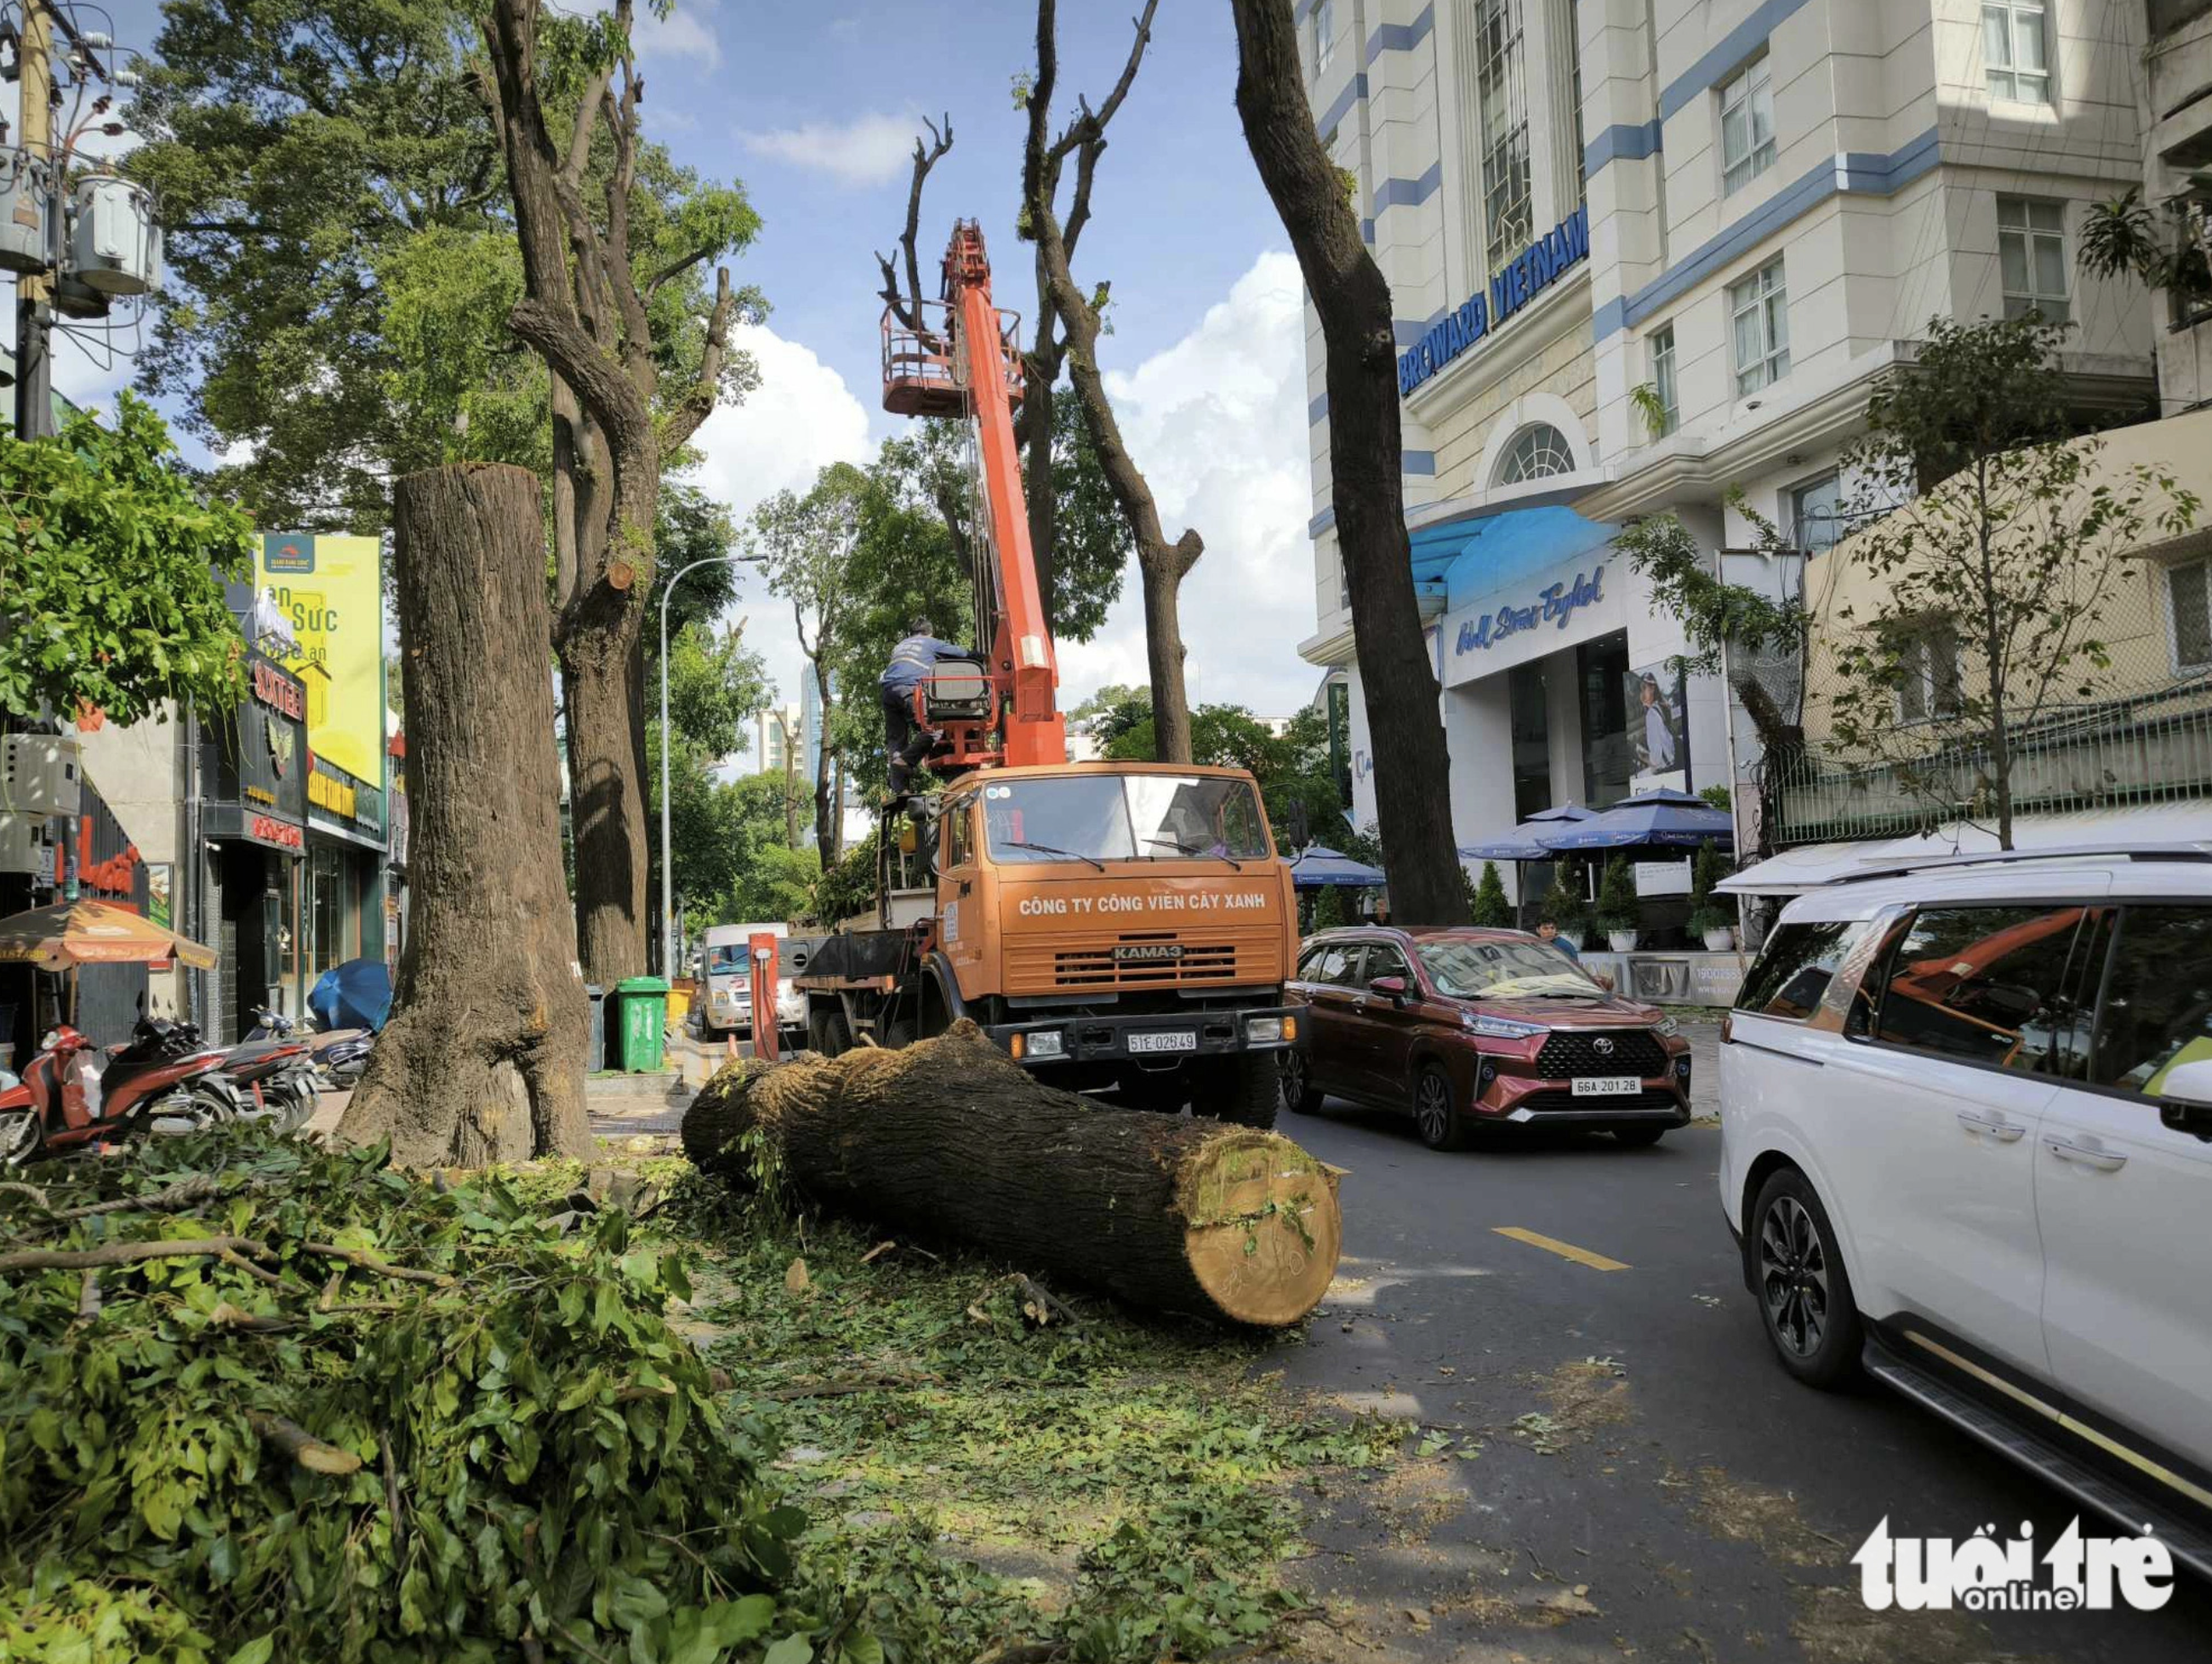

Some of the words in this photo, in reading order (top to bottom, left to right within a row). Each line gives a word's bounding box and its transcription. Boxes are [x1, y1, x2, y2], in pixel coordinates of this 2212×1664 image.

[1399, 291, 1487, 394] BROWARD
[1491, 202, 1588, 319] VIETNAM
[1019, 896, 1066, 915] CÔNG
[1072, 898, 1092, 914] TY
[1097, 893, 1143, 912] CÔNG
[1148, 891, 1184, 910] VIÊN
[1189, 891, 1219, 909] CÂY
[1224, 893, 1265, 910] XANH
